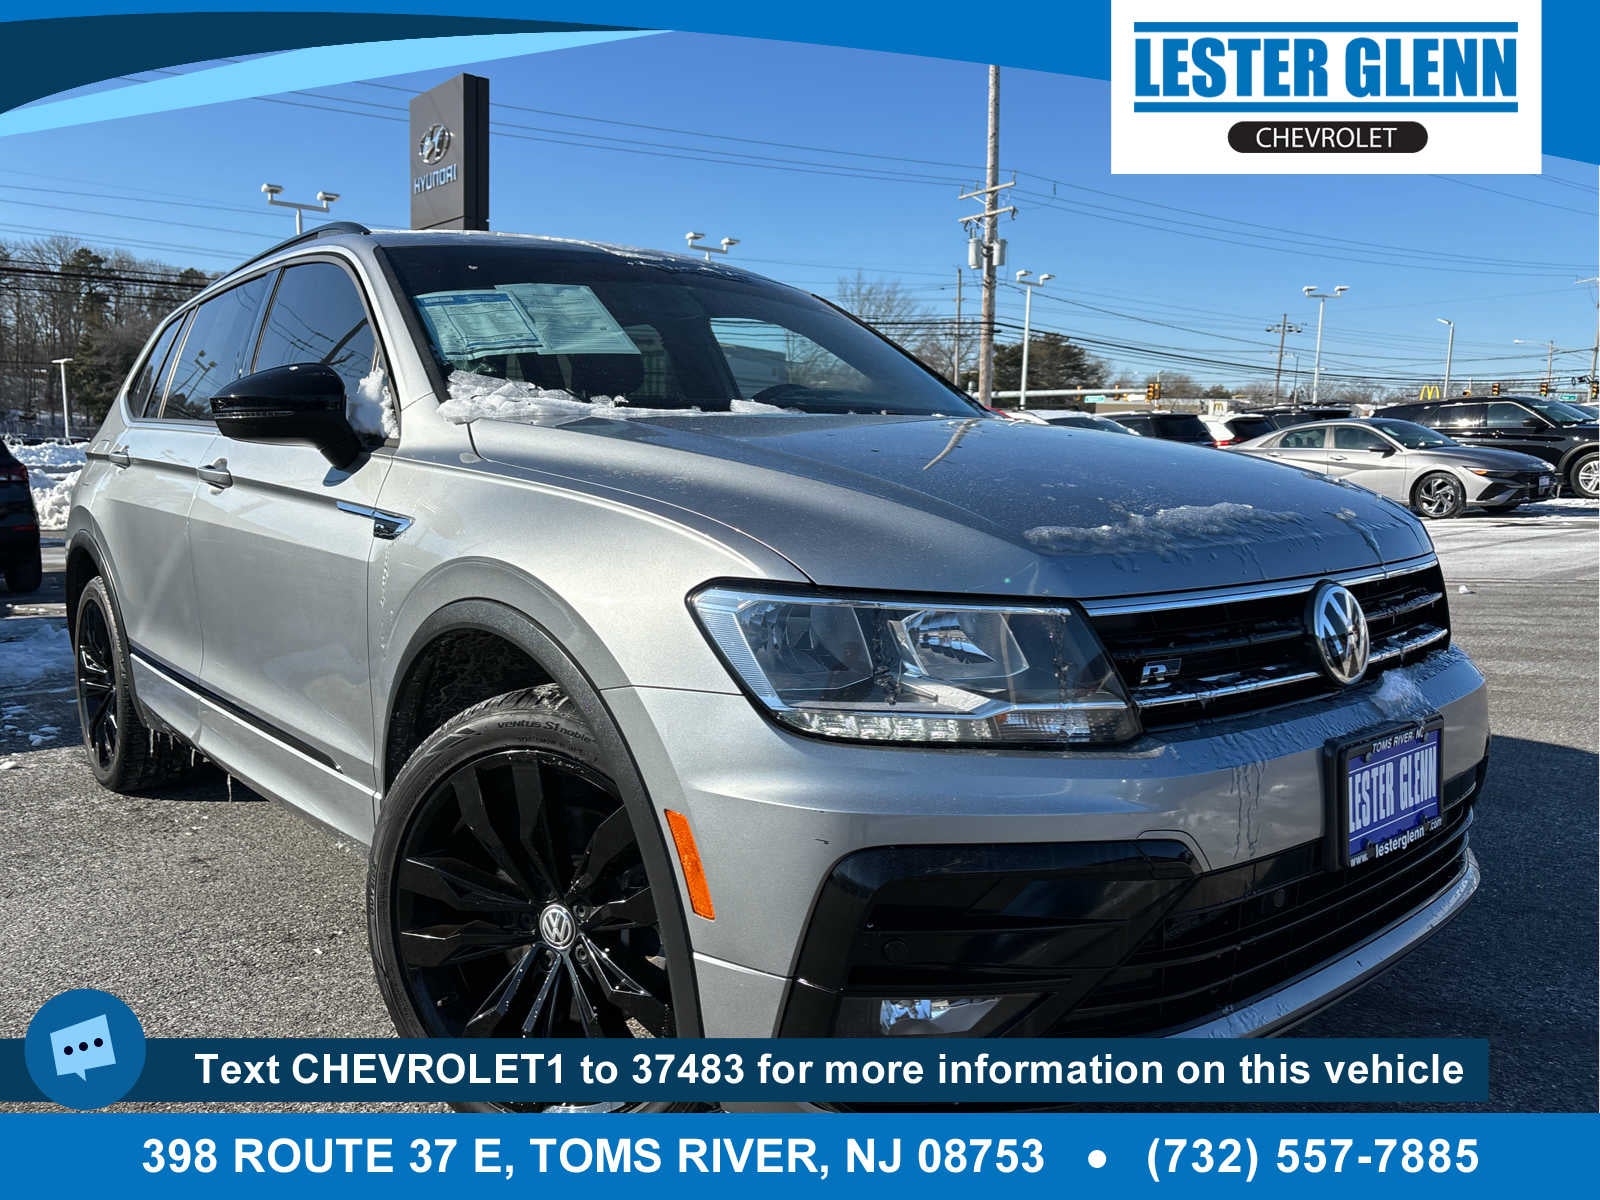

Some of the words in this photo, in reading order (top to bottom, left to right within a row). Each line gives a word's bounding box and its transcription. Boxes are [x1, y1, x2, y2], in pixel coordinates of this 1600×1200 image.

[413, 163, 457, 195] HYUNDAI
[1372, 737, 1392, 753] TOMS
[1348, 761, 1395, 834] LESTER
[1399, 745, 1438, 812] GLENN
